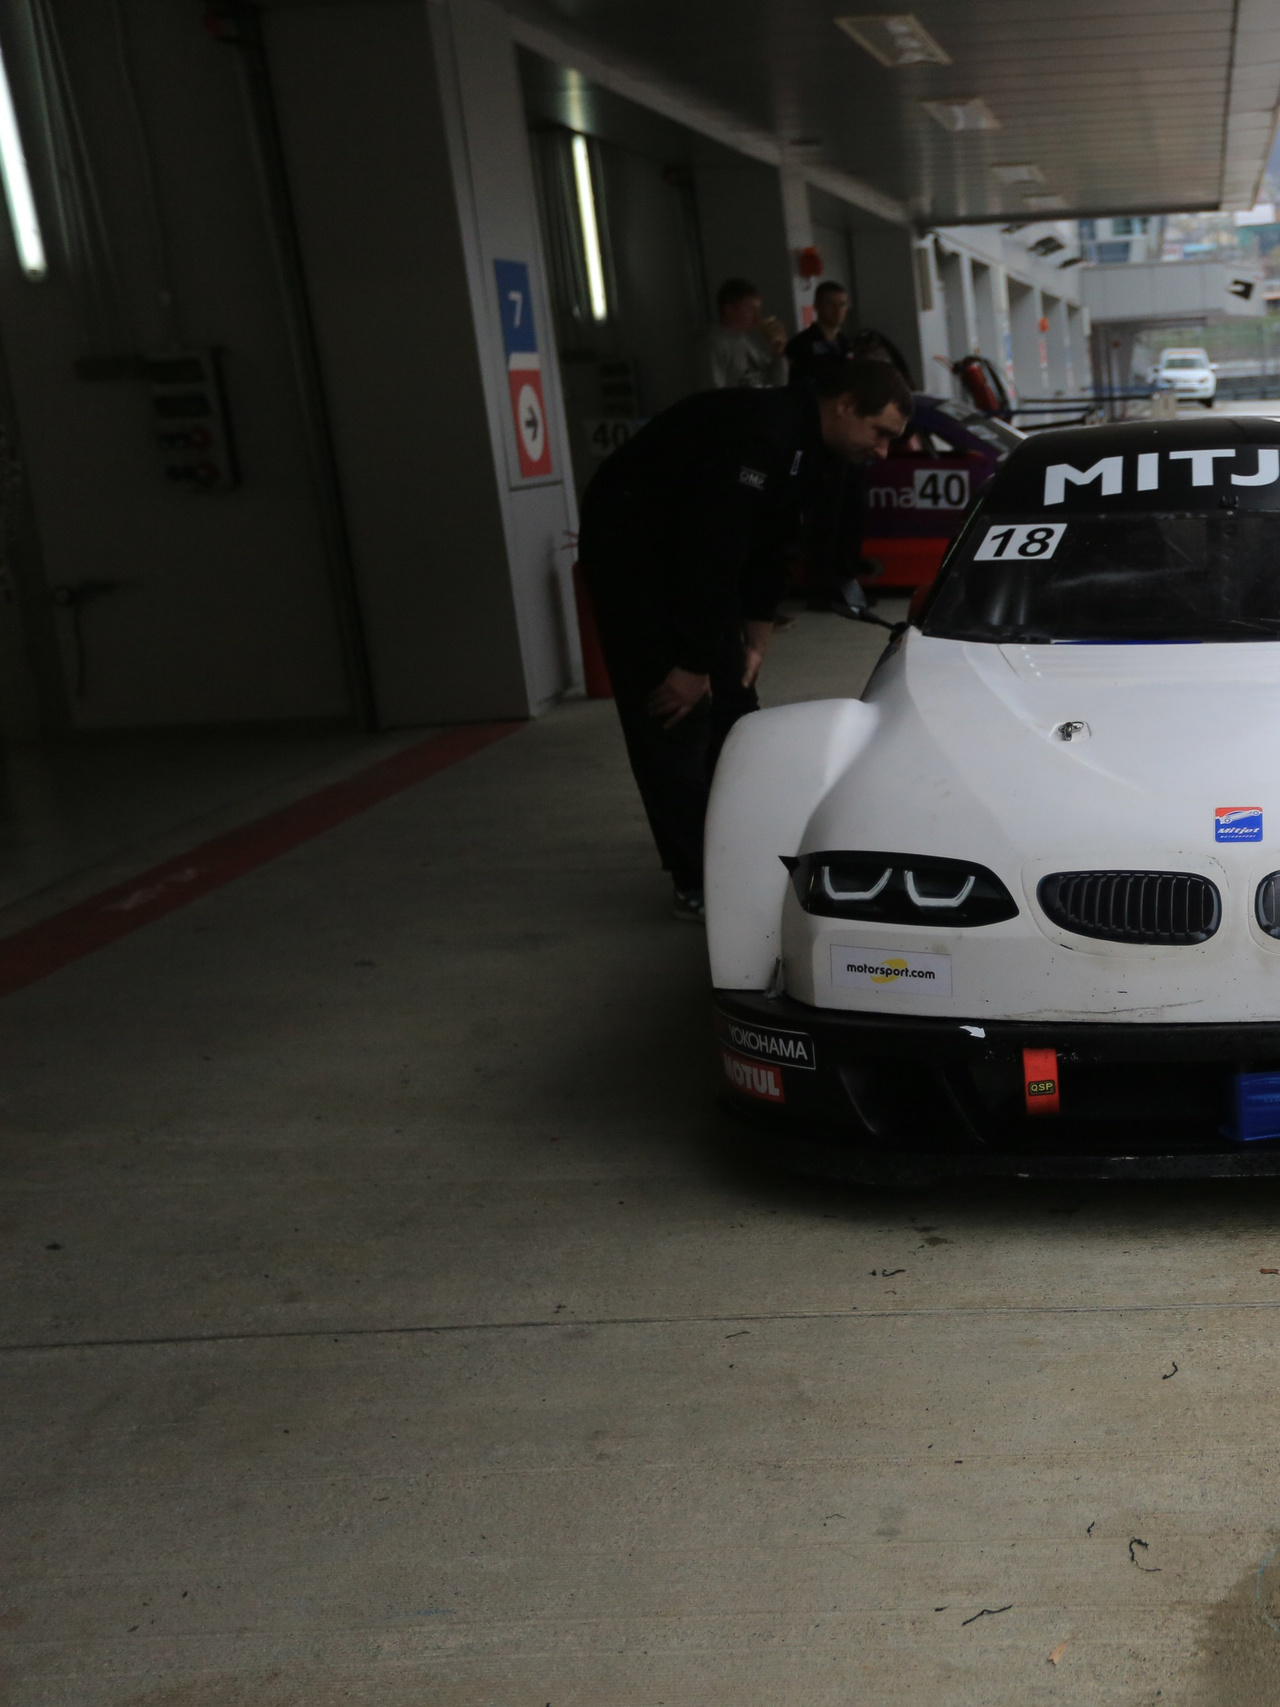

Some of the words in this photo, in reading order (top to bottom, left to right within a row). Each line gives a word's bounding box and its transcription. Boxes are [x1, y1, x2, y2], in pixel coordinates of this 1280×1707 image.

[507, 290, 523, 329] 7
[918, 473, 966, 507] 40
[990, 526, 1056, 558] 18
[846, 963, 936, 980] motorsport.com
[728, 1023, 809, 1061] YOKOHAMA
[722, 1052, 780, 1097] MOTUL
[1031, 1082, 1054, 1093] QSP
